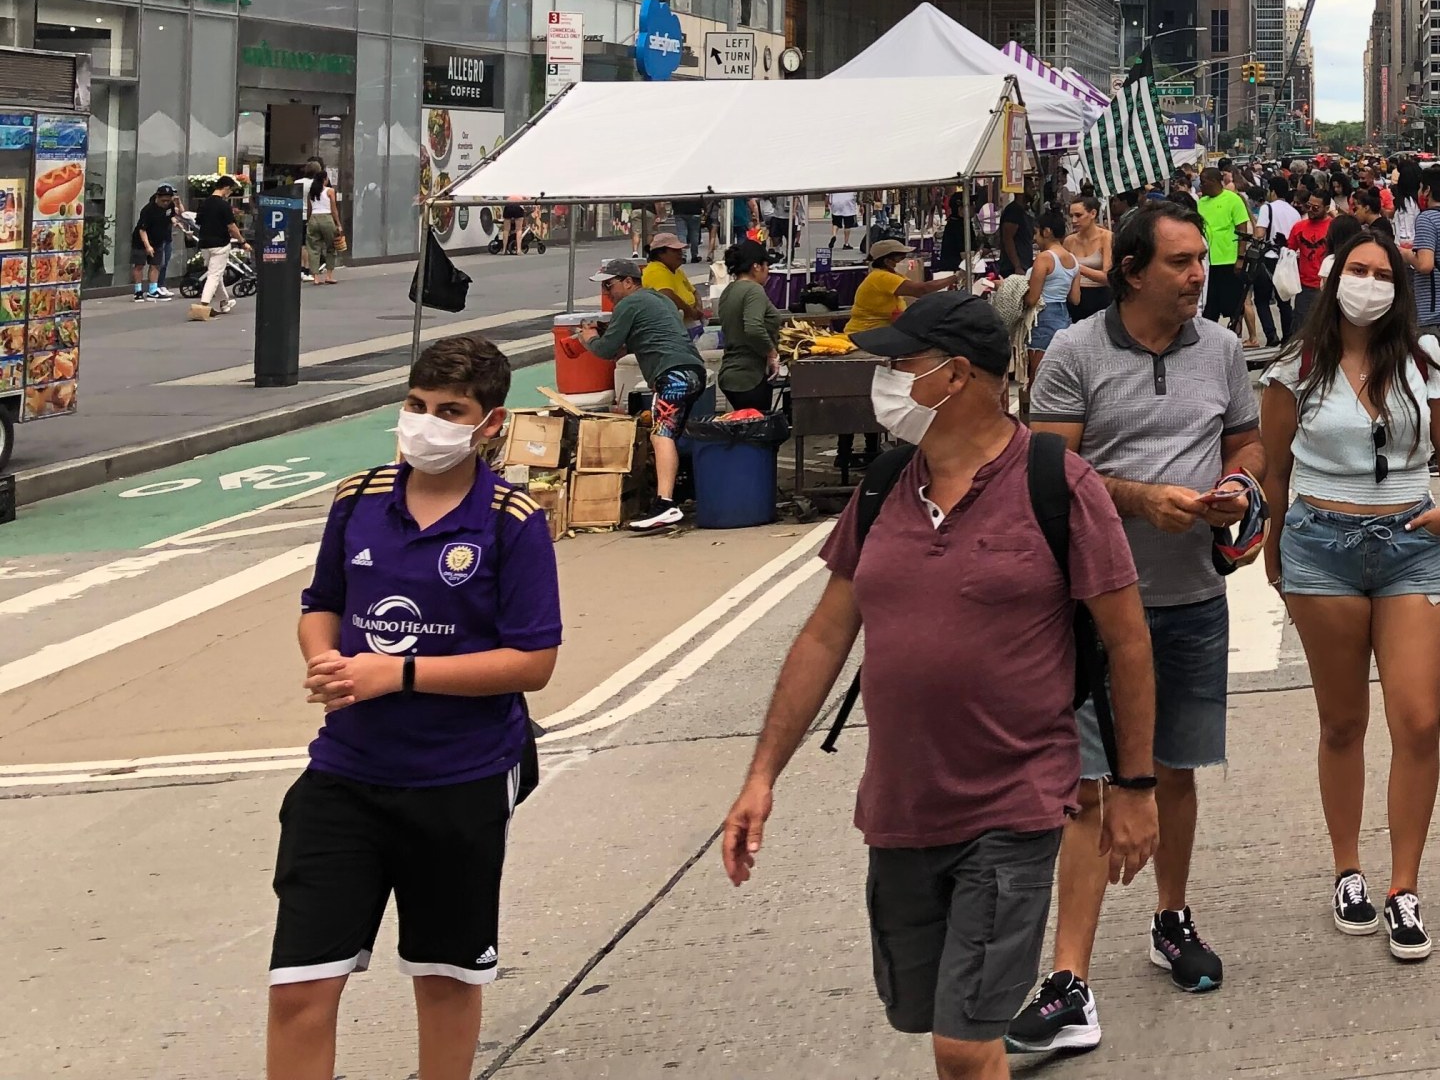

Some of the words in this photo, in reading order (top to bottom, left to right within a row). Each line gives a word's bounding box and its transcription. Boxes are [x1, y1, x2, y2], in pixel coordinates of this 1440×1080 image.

[551, 13, 558, 23] 3
[725, 39, 750, 48] LEFT
[725, 52, 750, 61] TURN
[447, 56, 484, 83] ALLEGRO
[549, 64, 556, 74] 5
[724, 65, 750, 74] LANE
[450, 85, 481, 99] COFFEE
[271, 210, 284, 229] P
[351, 558, 374, 567] adidas
[352, 613, 399, 633] ORLANDO
[400, 620, 456, 635] HEALTH
[475, 954, 498, 964] adidas
